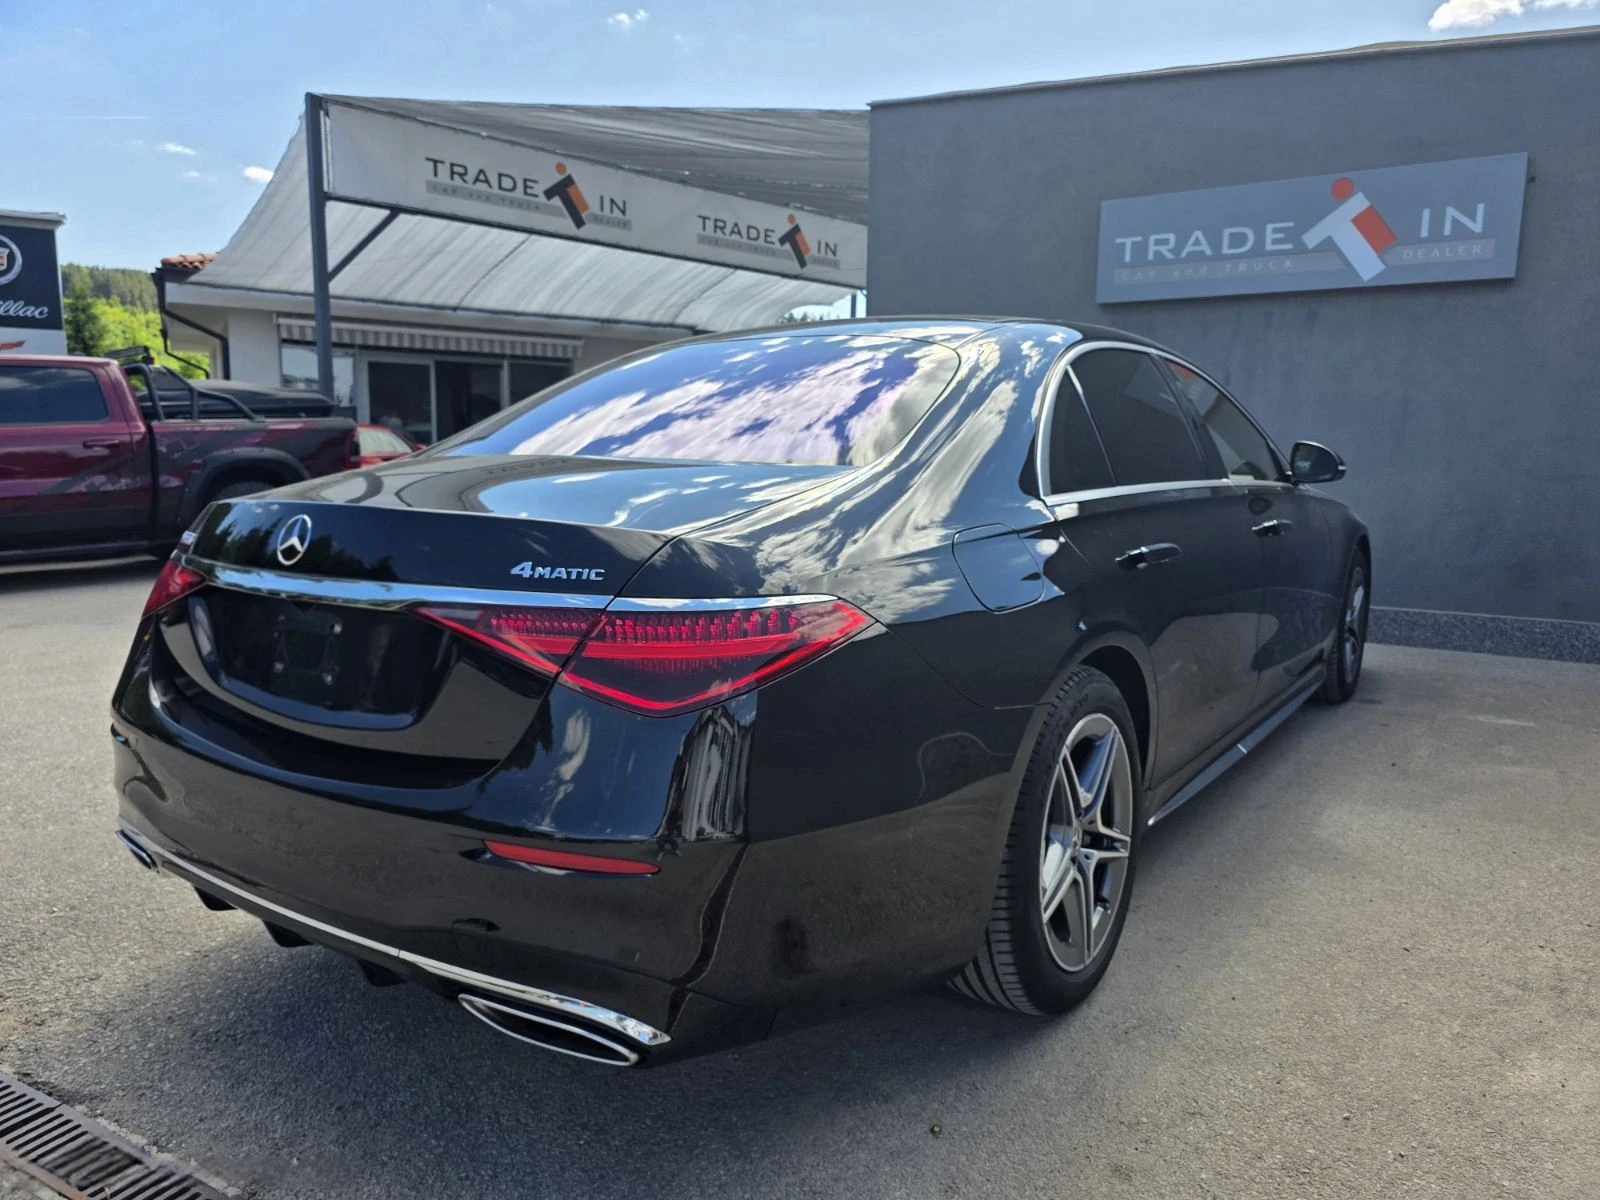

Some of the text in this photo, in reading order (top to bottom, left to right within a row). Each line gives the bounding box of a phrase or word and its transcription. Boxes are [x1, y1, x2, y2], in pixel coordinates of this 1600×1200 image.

[425, 157, 540, 198] TRADE
[599, 195, 627, 217] IN
[697, 215, 776, 246] TRADE
[817, 239, 838, 258] IN
[1115, 221, 1296, 263] TRADE
[1419, 202, 1486, 238] IN
[1121, 270, 1157, 282] CAR
[1223, 257, 1296, 274] TRUCK
[1402, 244, 1484, 261] DEALER
[510, 561, 605, 581] 4MATIC
